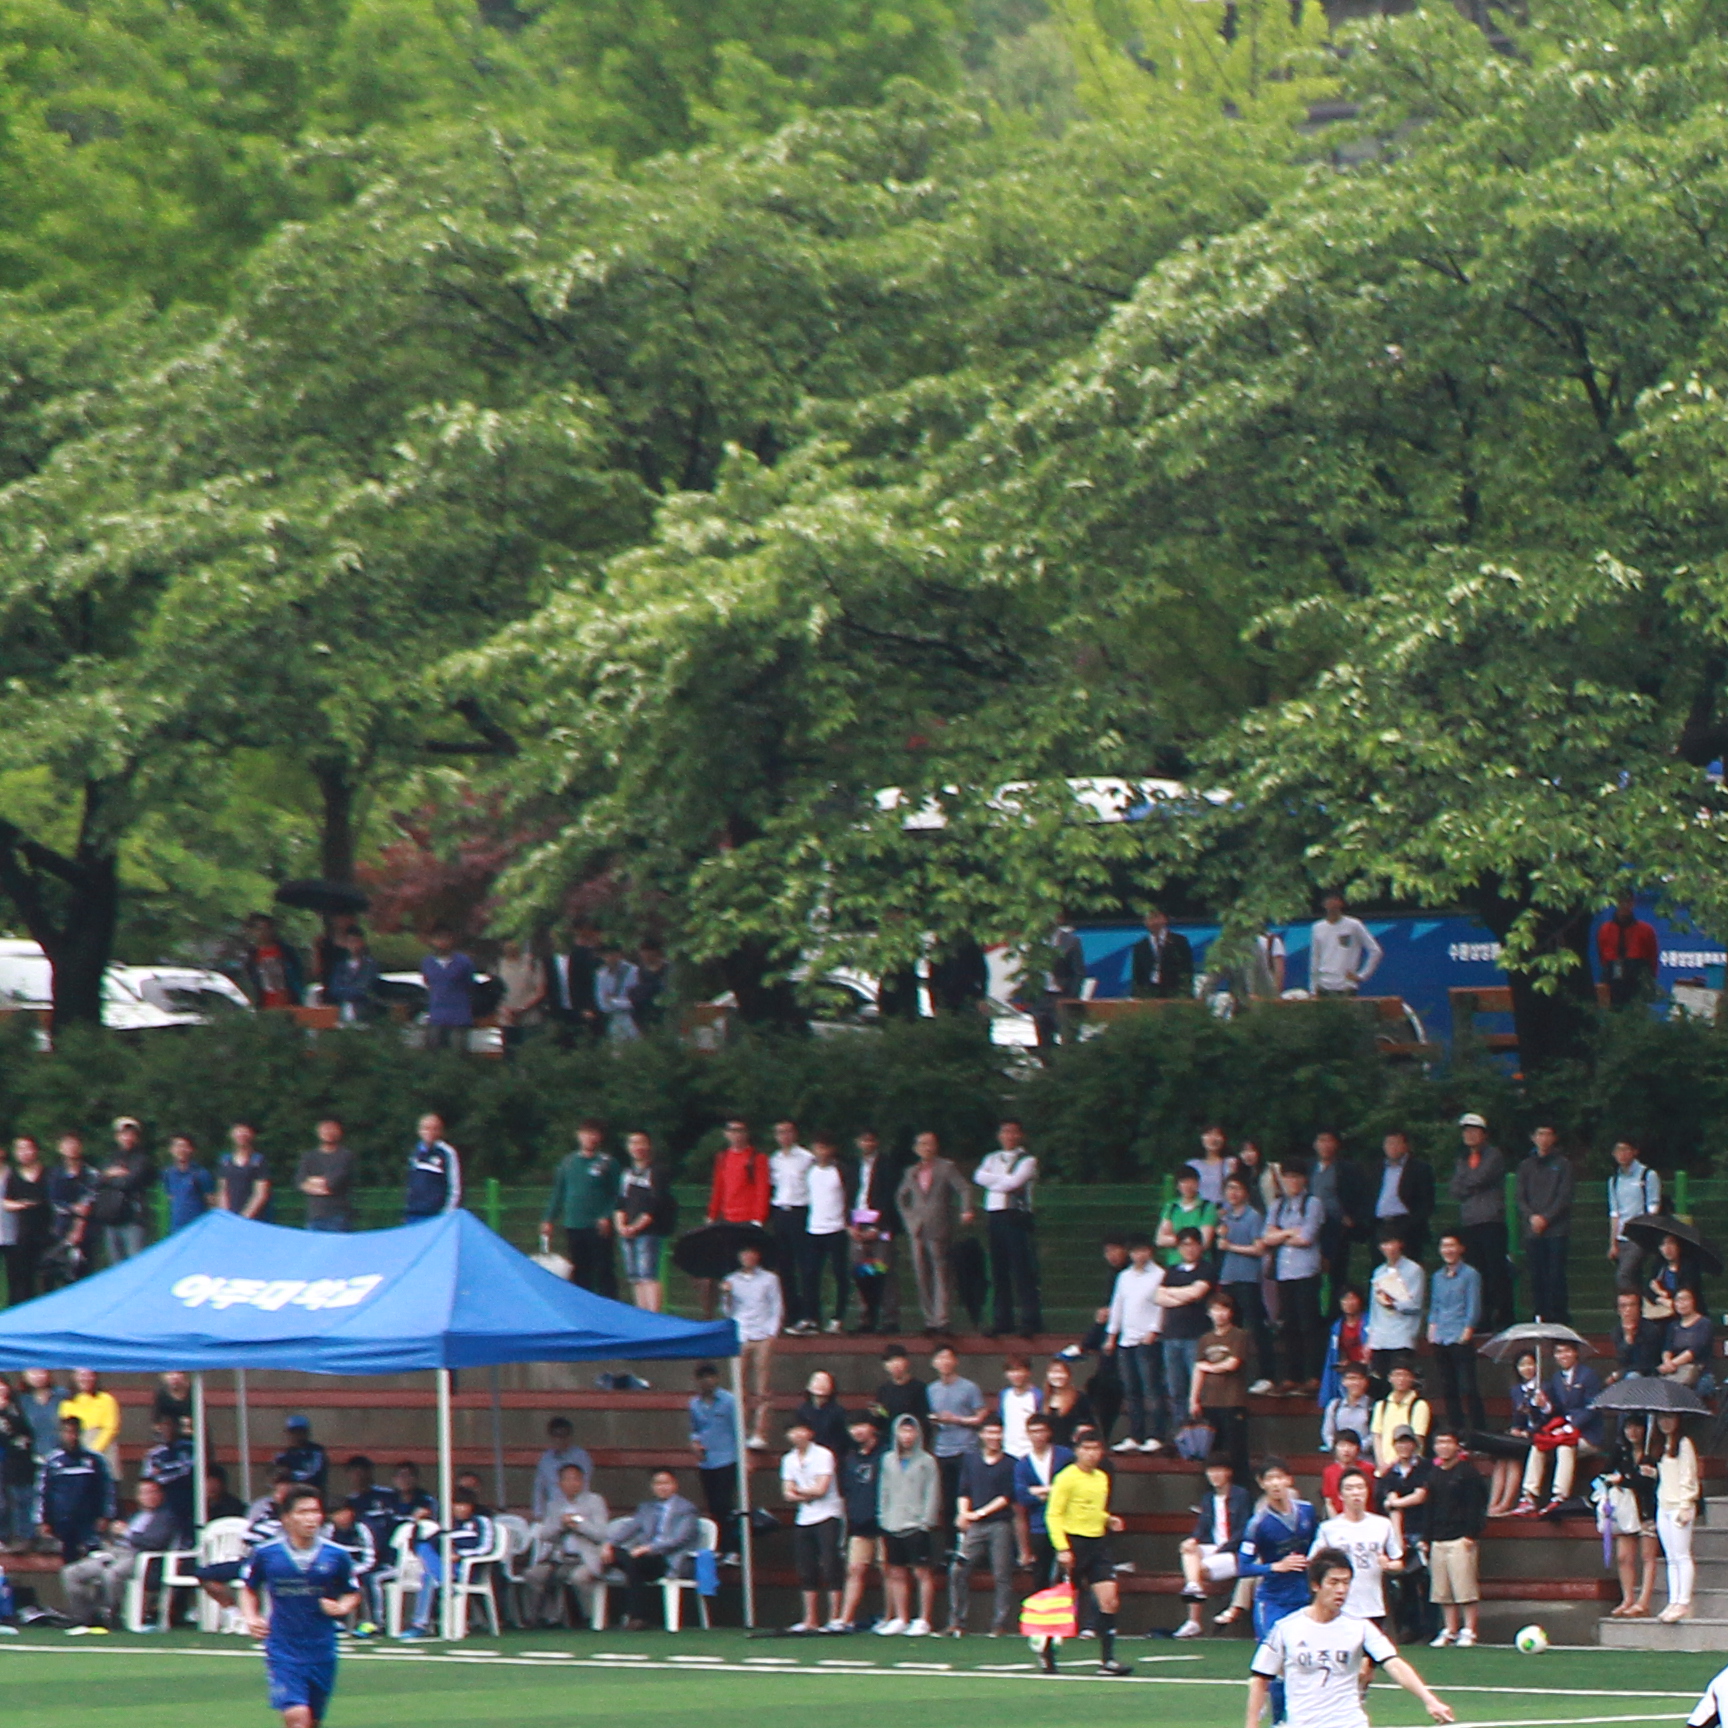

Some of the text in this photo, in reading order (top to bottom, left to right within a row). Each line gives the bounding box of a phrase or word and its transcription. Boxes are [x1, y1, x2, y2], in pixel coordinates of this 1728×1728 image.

[171, 1273, 384, 1311] 아주대학교
[1298, 1650, 1349, 1666] 아주대
[1318, 1666, 1331, 1687] 7
